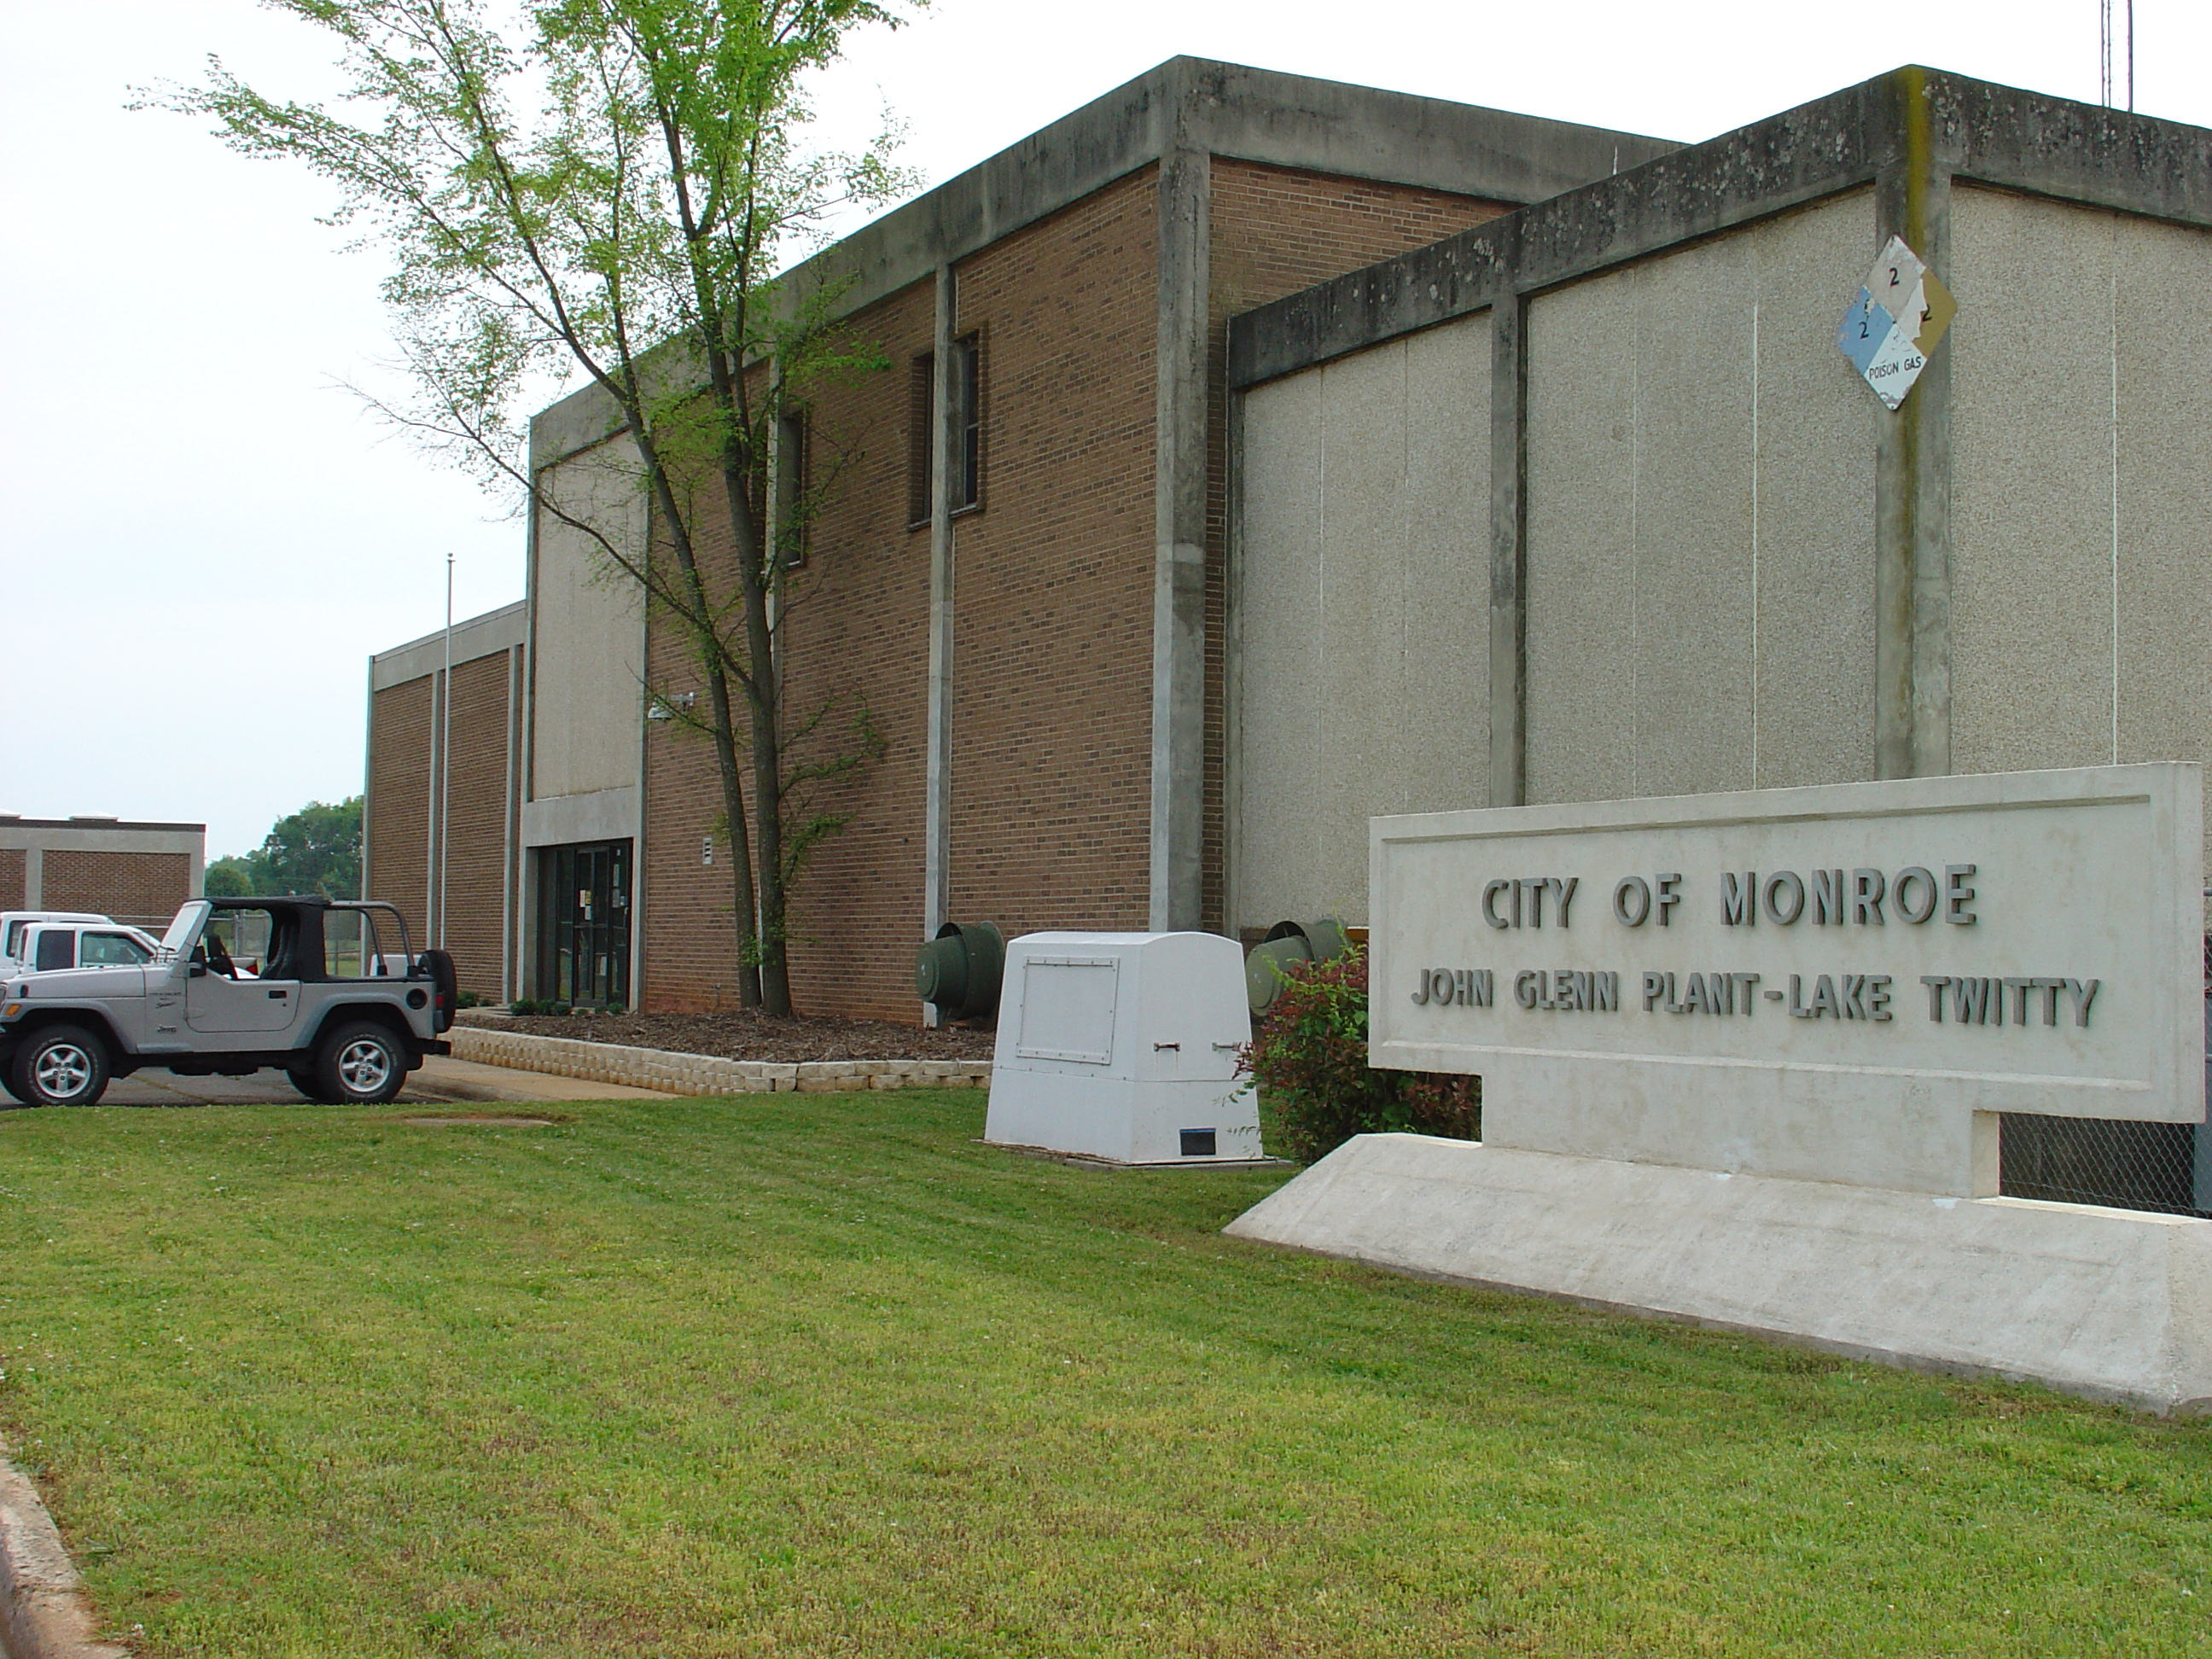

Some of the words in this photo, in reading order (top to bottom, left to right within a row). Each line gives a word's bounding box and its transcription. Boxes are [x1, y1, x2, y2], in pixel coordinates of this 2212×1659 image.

[1889, 267, 1900, 286] 2
[1922, 304, 1932, 322] 2
[1859, 322, 1869, 339] 2
[1868, 363, 1899, 380] POISON
[1903, 356, 1922, 371] GAS
[1481, 877, 1579, 929] CITY
[1613, 872, 1682, 928] OF
[1720, 864, 1976, 926] MONROE
[1411, 968, 1493, 1008] JOHN
[1513, 969, 1618, 1012] GLENN
[1919, 975, 2100, 1027] TWITTY
